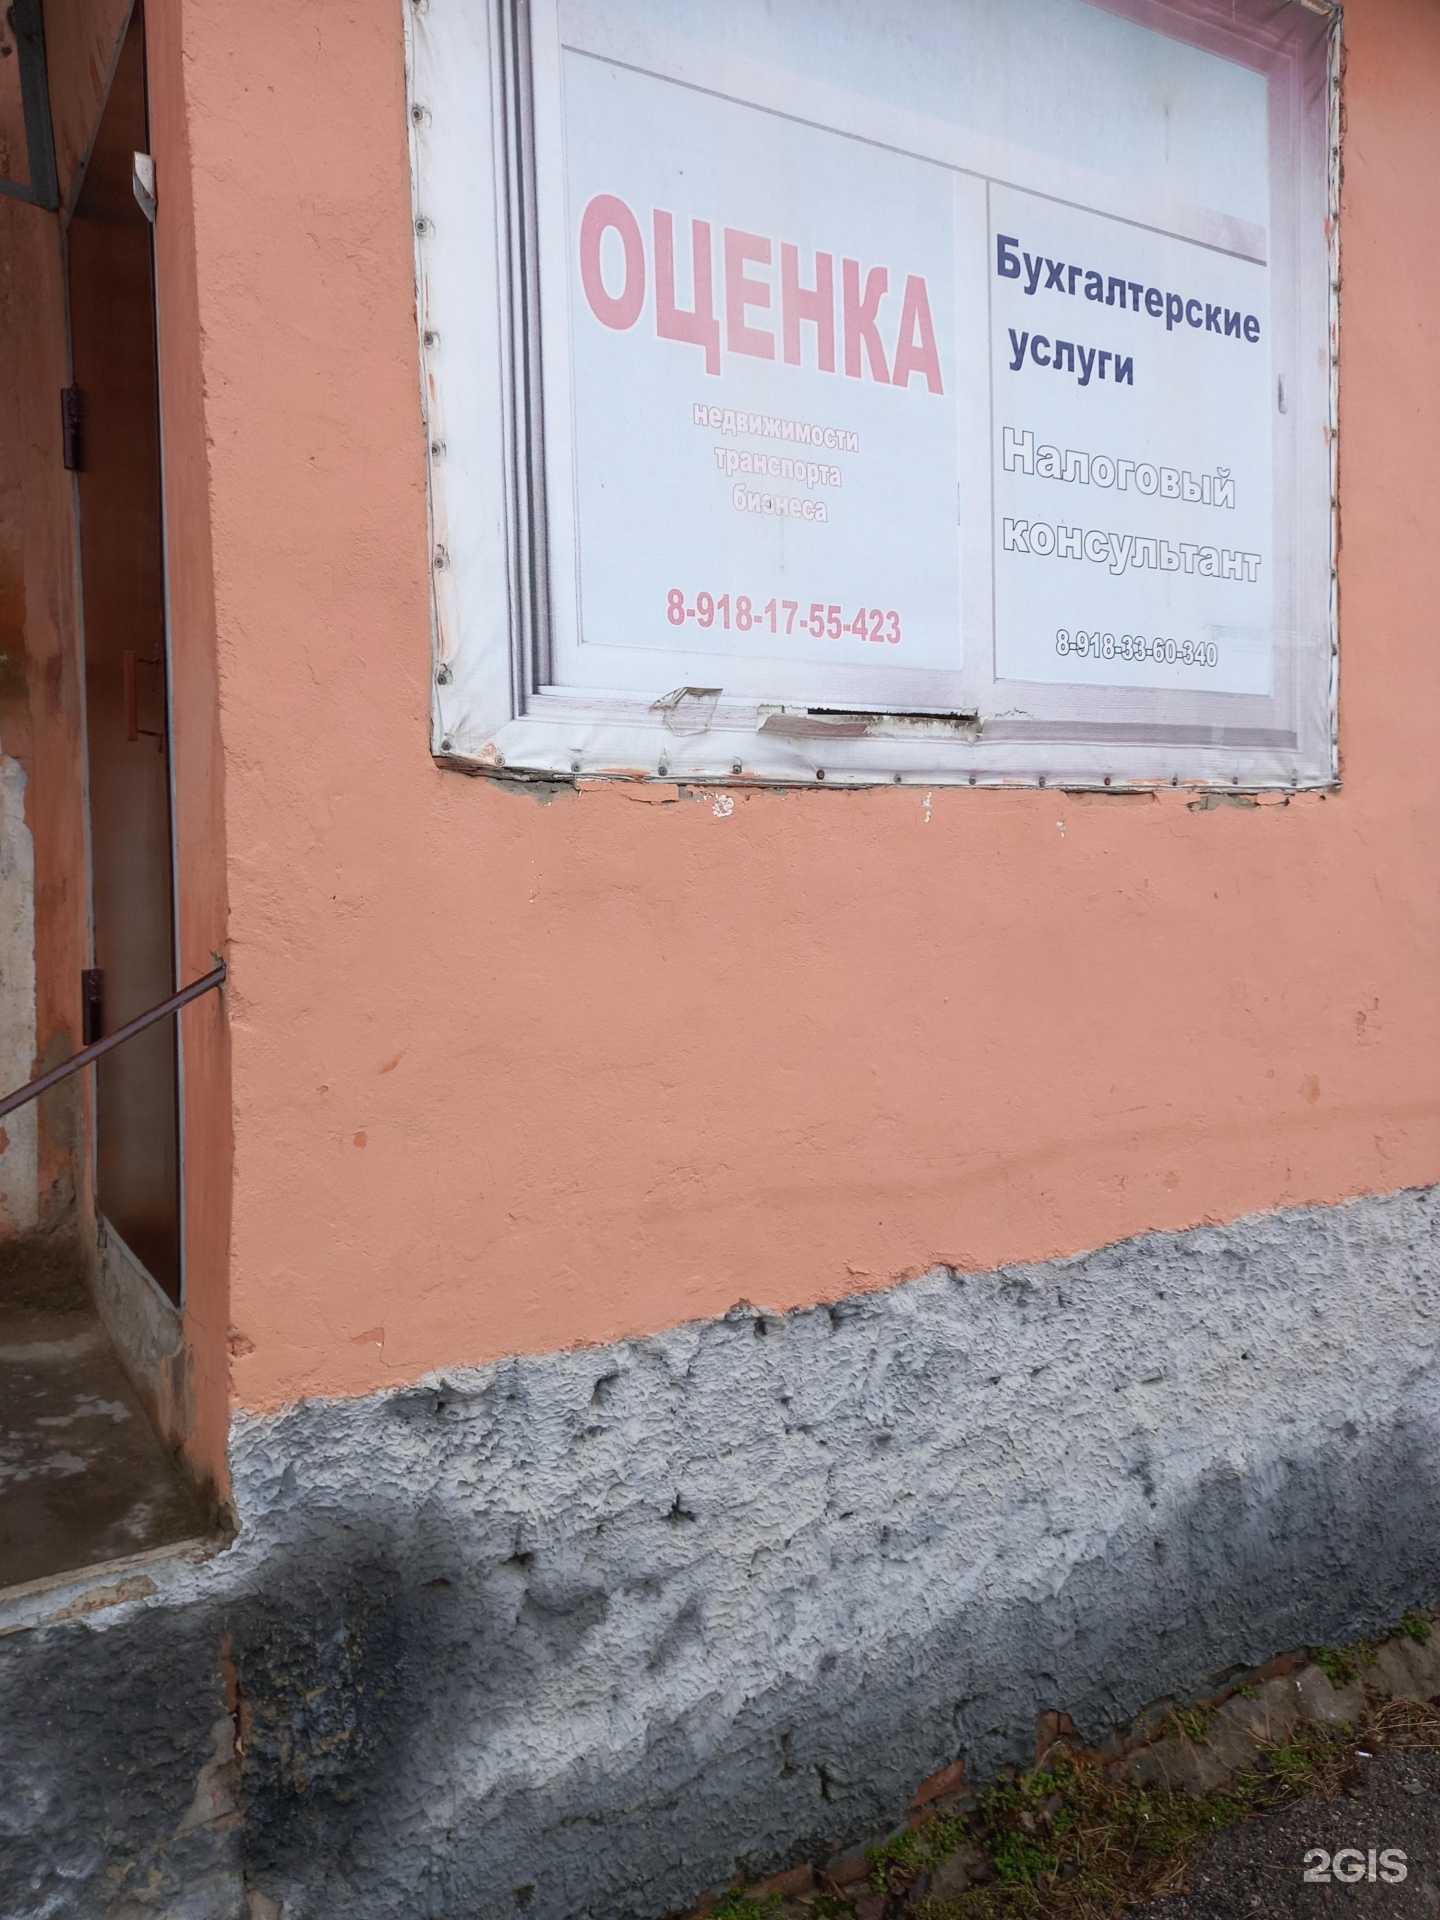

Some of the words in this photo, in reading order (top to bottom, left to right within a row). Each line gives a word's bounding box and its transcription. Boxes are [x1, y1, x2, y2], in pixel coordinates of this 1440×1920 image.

[580, 193, 944, 395] ОЦЕНКА
[997, 233, 1261, 343] Бухгалтерские
[1008, 328, 1134, 386] услуги
[693, 403, 860, 453] недвижимости
[714, 447, 842, 489] транспорта
[1003, 426, 1236, 509] Налоговый
[731, 483, 828, 522] бизнеса
[1003, 518, 1262, 582] консультант
[666, 588, 902, 644] 8-918-17-55-423
[1056, 629, 1218, 667] 8-918-33-60-340
